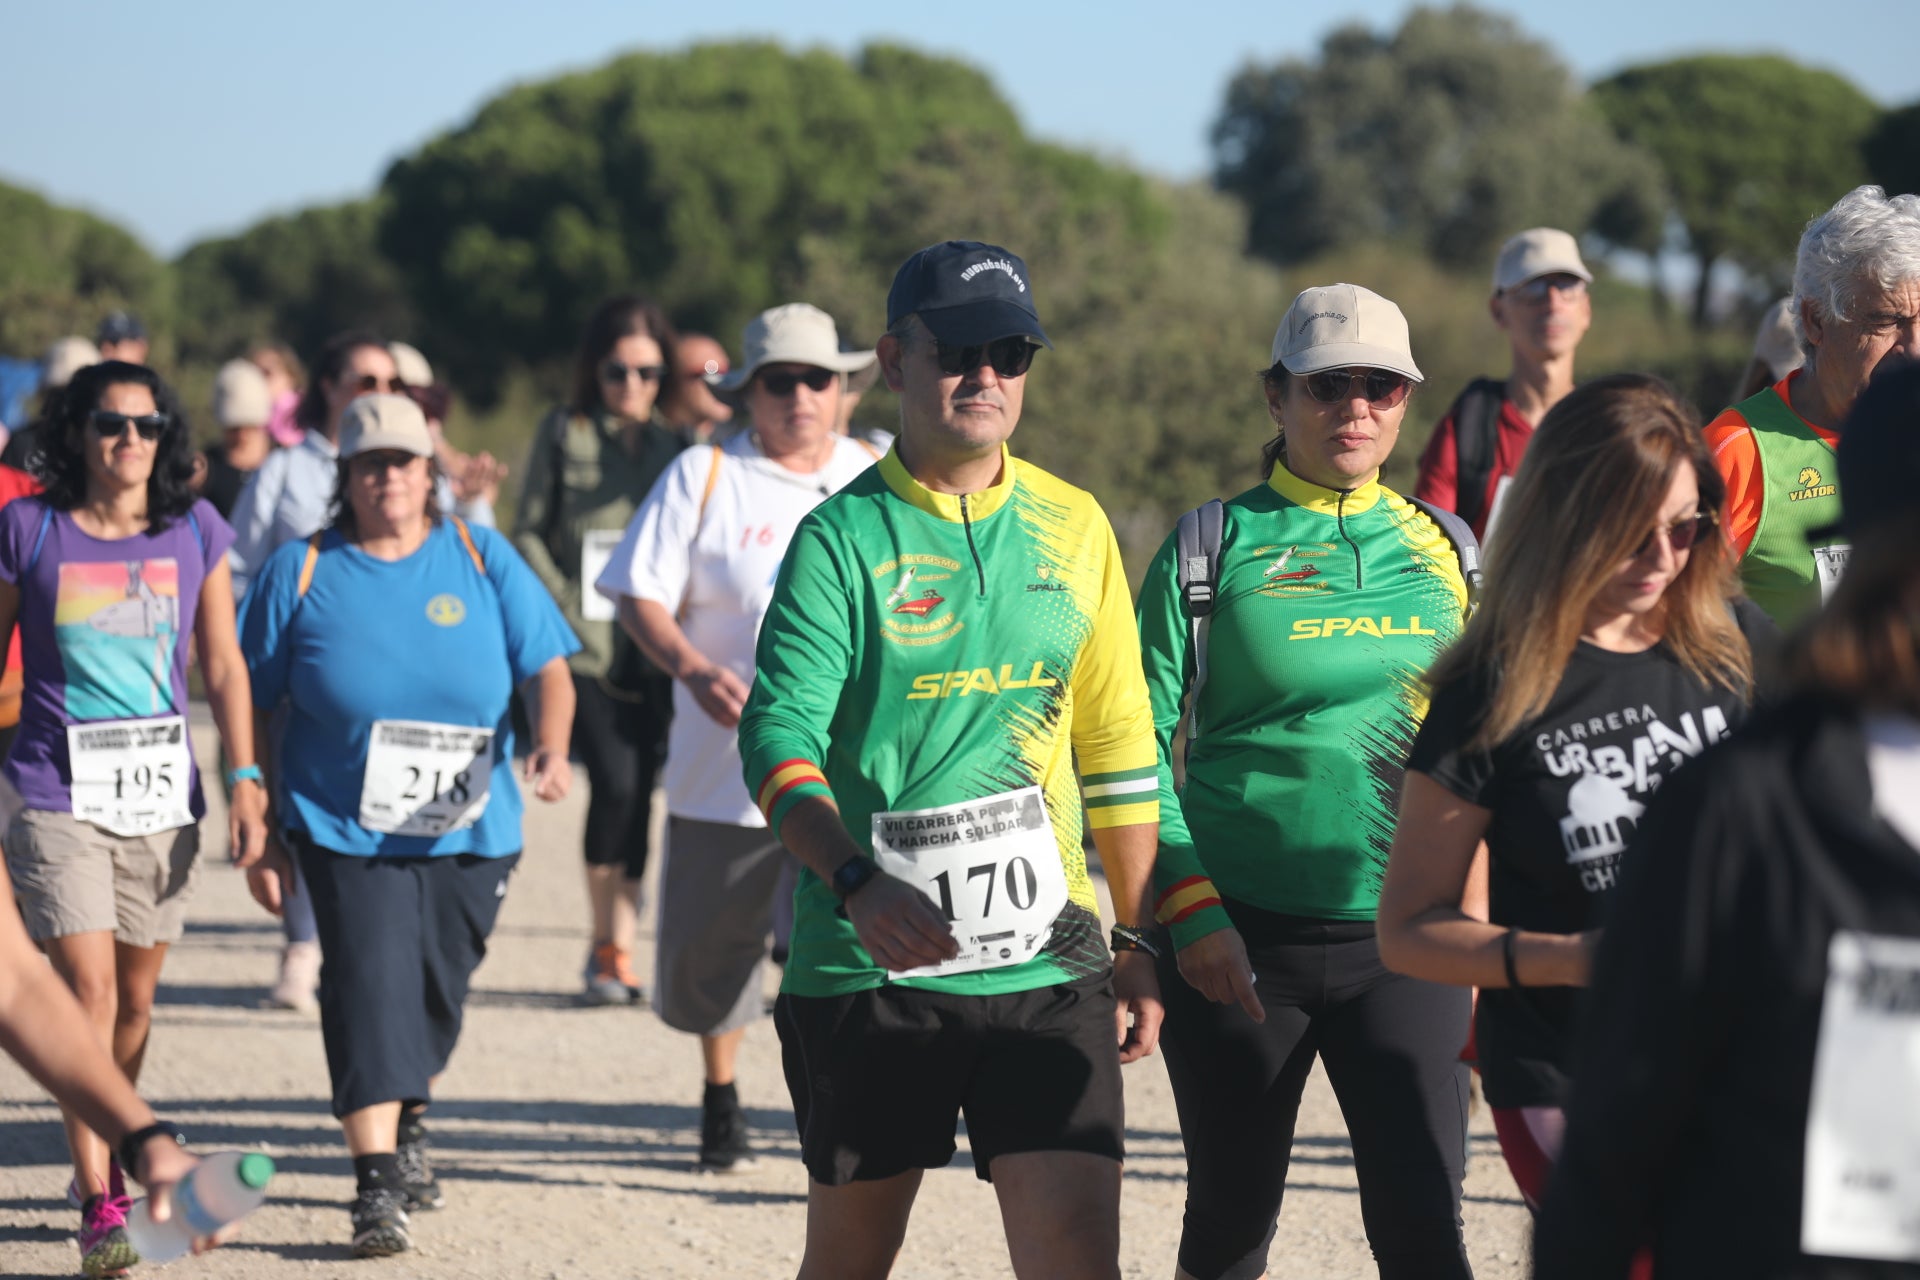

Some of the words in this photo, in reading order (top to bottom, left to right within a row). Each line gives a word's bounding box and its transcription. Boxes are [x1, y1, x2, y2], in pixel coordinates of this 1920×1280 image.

[961, 258, 1025, 292] nuevabahia.org
[1298, 311, 1348, 334] nuevabahia.org
[1789, 485, 1836, 501] VIATOR
[1026, 584, 1068, 592] SPALL
[1829, 567, 1839, 577] Y
[1288, 616, 1436, 640] SPALL
[906, 661, 1057, 700] SPALL
[1536, 704, 1657, 751] CARRERA
[1544, 705, 1732, 792] URBANA
[115, 763, 172, 799] 195
[400, 764, 470, 807] 218
[885, 819, 903, 833] VII
[906, 811, 975, 832] CARRERA
[886, 837, 895, 849] Y
[899, 829, 961, 849] MARCHA
[965, 818, 1025, 840] SOLIDAR
[929, 856, 1038, 922] 170
